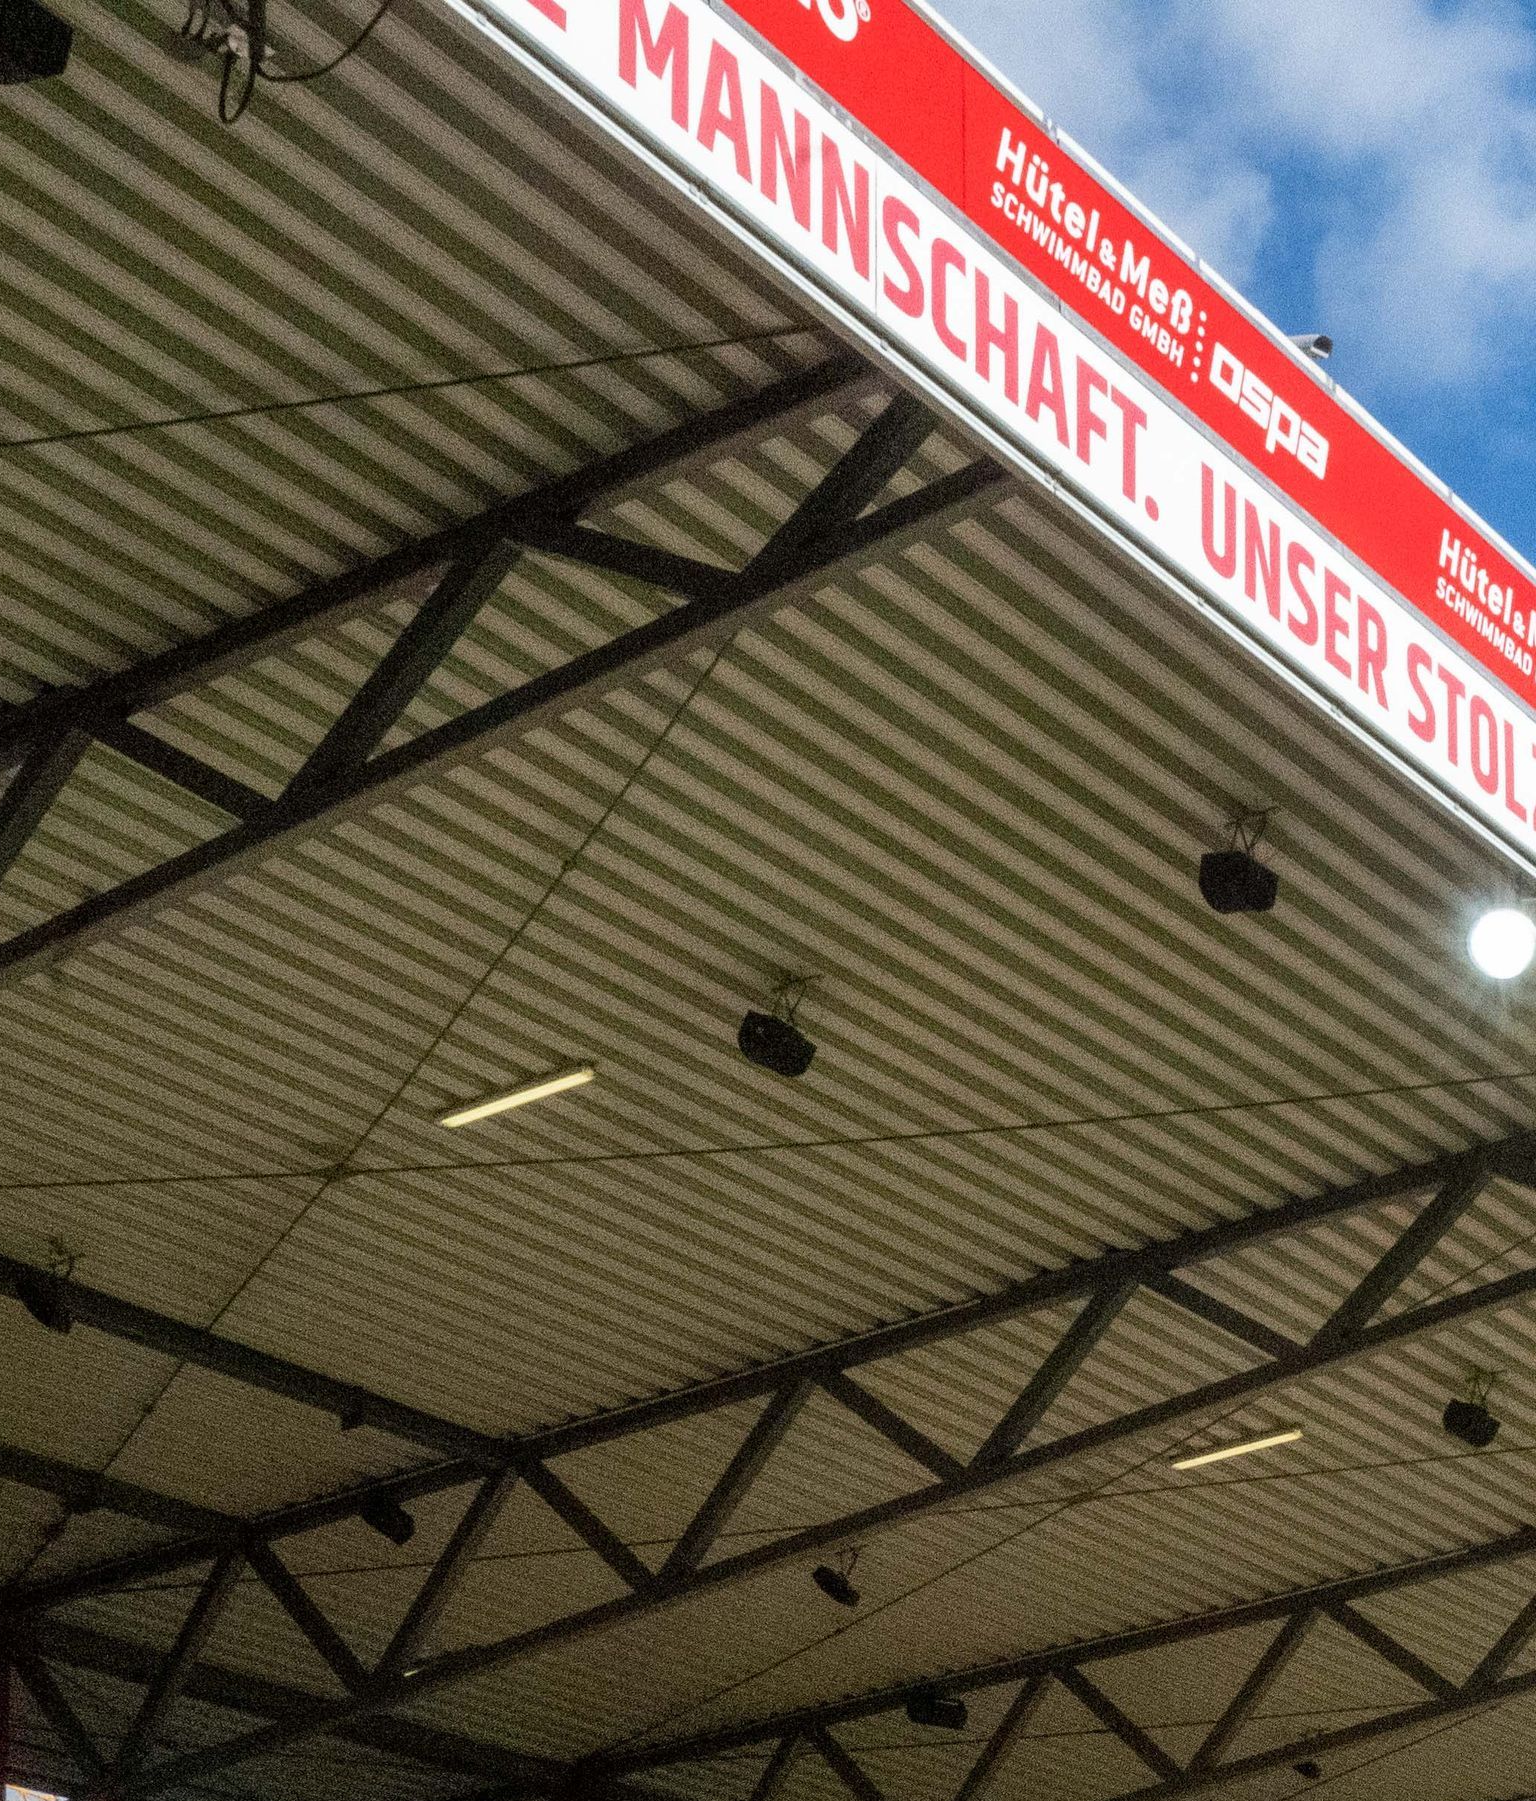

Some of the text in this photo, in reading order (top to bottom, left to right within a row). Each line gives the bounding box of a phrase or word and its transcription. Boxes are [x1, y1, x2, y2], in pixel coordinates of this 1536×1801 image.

[617, 0, 1161, 523] MANNSCHAFT.
[1200, 461, 1388, 711] UNSER
[991, 182, 1185, 368] SCHWIMMBAD GMBH
[1212, 343, 1331, 479] ospa
[1435, 576, 1533, 679] SCHWIMMBAD
